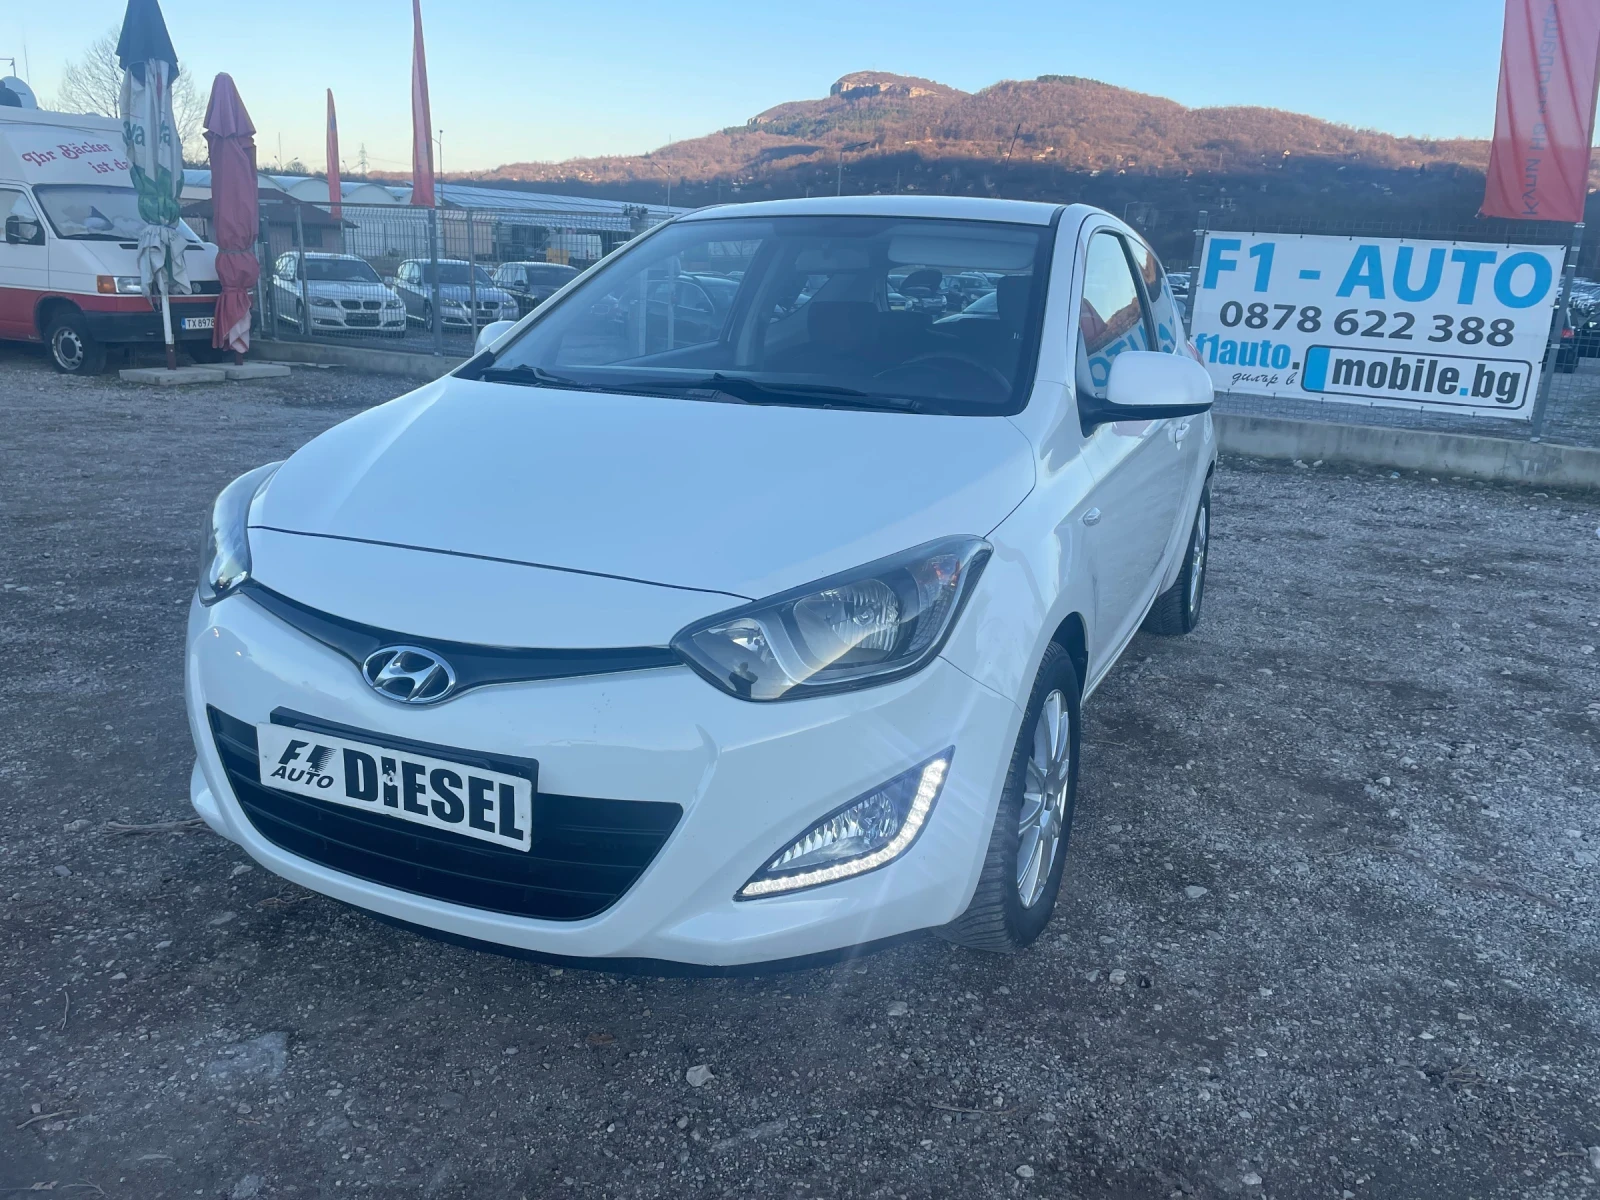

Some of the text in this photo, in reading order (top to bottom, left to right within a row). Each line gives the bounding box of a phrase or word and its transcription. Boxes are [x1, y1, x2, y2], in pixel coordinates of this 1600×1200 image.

[21, 141, 113, 167] Ihr Bäcker
[87, 161, 115, 174] ist
[1203, 238, 1276, 293] F1
[1336, 245, 1553, 309] AUTO
[1219, 300, 1515, 347] 0878 622 388
[1231, 372, 1279, 387] дилър
[1331, 355, 1521, 403] mobile.bg
[270, 765, 334, 789] AUTO
[342, 747, 524, 842] DIESEL
